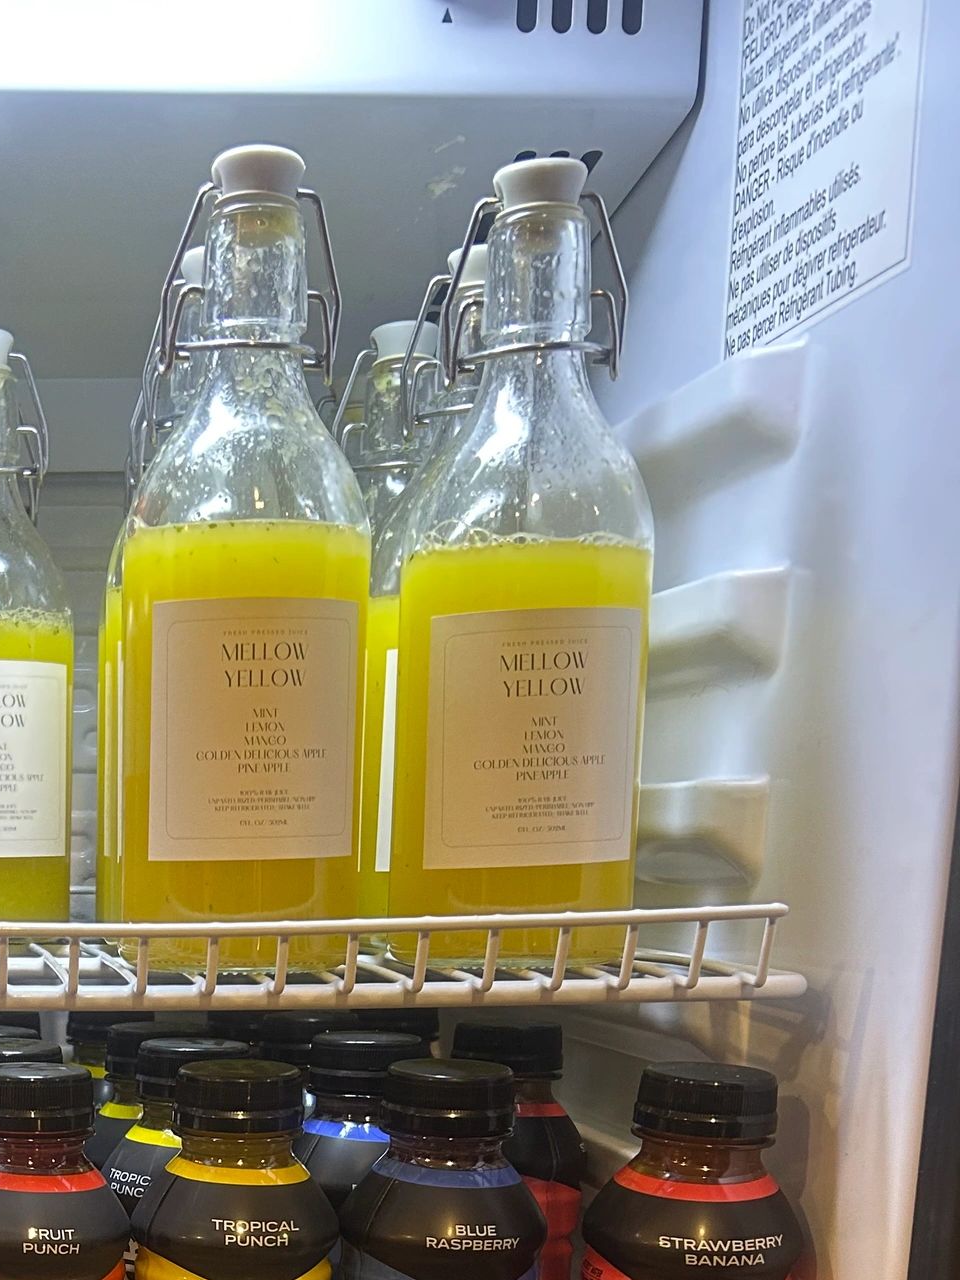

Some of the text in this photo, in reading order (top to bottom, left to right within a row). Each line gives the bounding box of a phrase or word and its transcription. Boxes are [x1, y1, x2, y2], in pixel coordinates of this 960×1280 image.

[734, 168, 771, 216] DANGER
[725, 335, 736, 357] Ne
[738, 329, 751, 351] pas
[752, 312, 778, 347] percer
[221, 641, 309, 661] MELLOW
[500, 651, 589, 672] MELLOW
[224, 668, 306, 688] YELLOW
[503, 677, 586, 698] YELLOW
[253, 708, 278, 719] MINT
[245, 722, 285, 732] LEMON
[531, 716, 558, 727] MINT
[244, 736, 286, 746] MANGO
[524, 730, 564, 740] LEMON
[196, 749, 326, 761] GOLDEN DELICIOUS APPLE
[522, 743, 565, 754] MANGO
[238, 763, 290, 774] PINEAPPLE
[474, 755, 606, 770] GOLDEN DELICIOUS APPLE
[516, 770, 569, 781] PINEAPPLE
[211, 1219, 300, 1233] TROPICAL
[455, 1225, 497, 1238] BLUE
[28, 1228, 75, 1243] FRUIT
[224, 1232, 289, 1247] PUNCH
[22, 1241, 81, 1256] PUNCH
[425, 1236, 520, 1251] RASPBERRY
[658, 1234, 784, 1253] STRAWBERRY
[684, 1253, 765, 1267] BANANA
